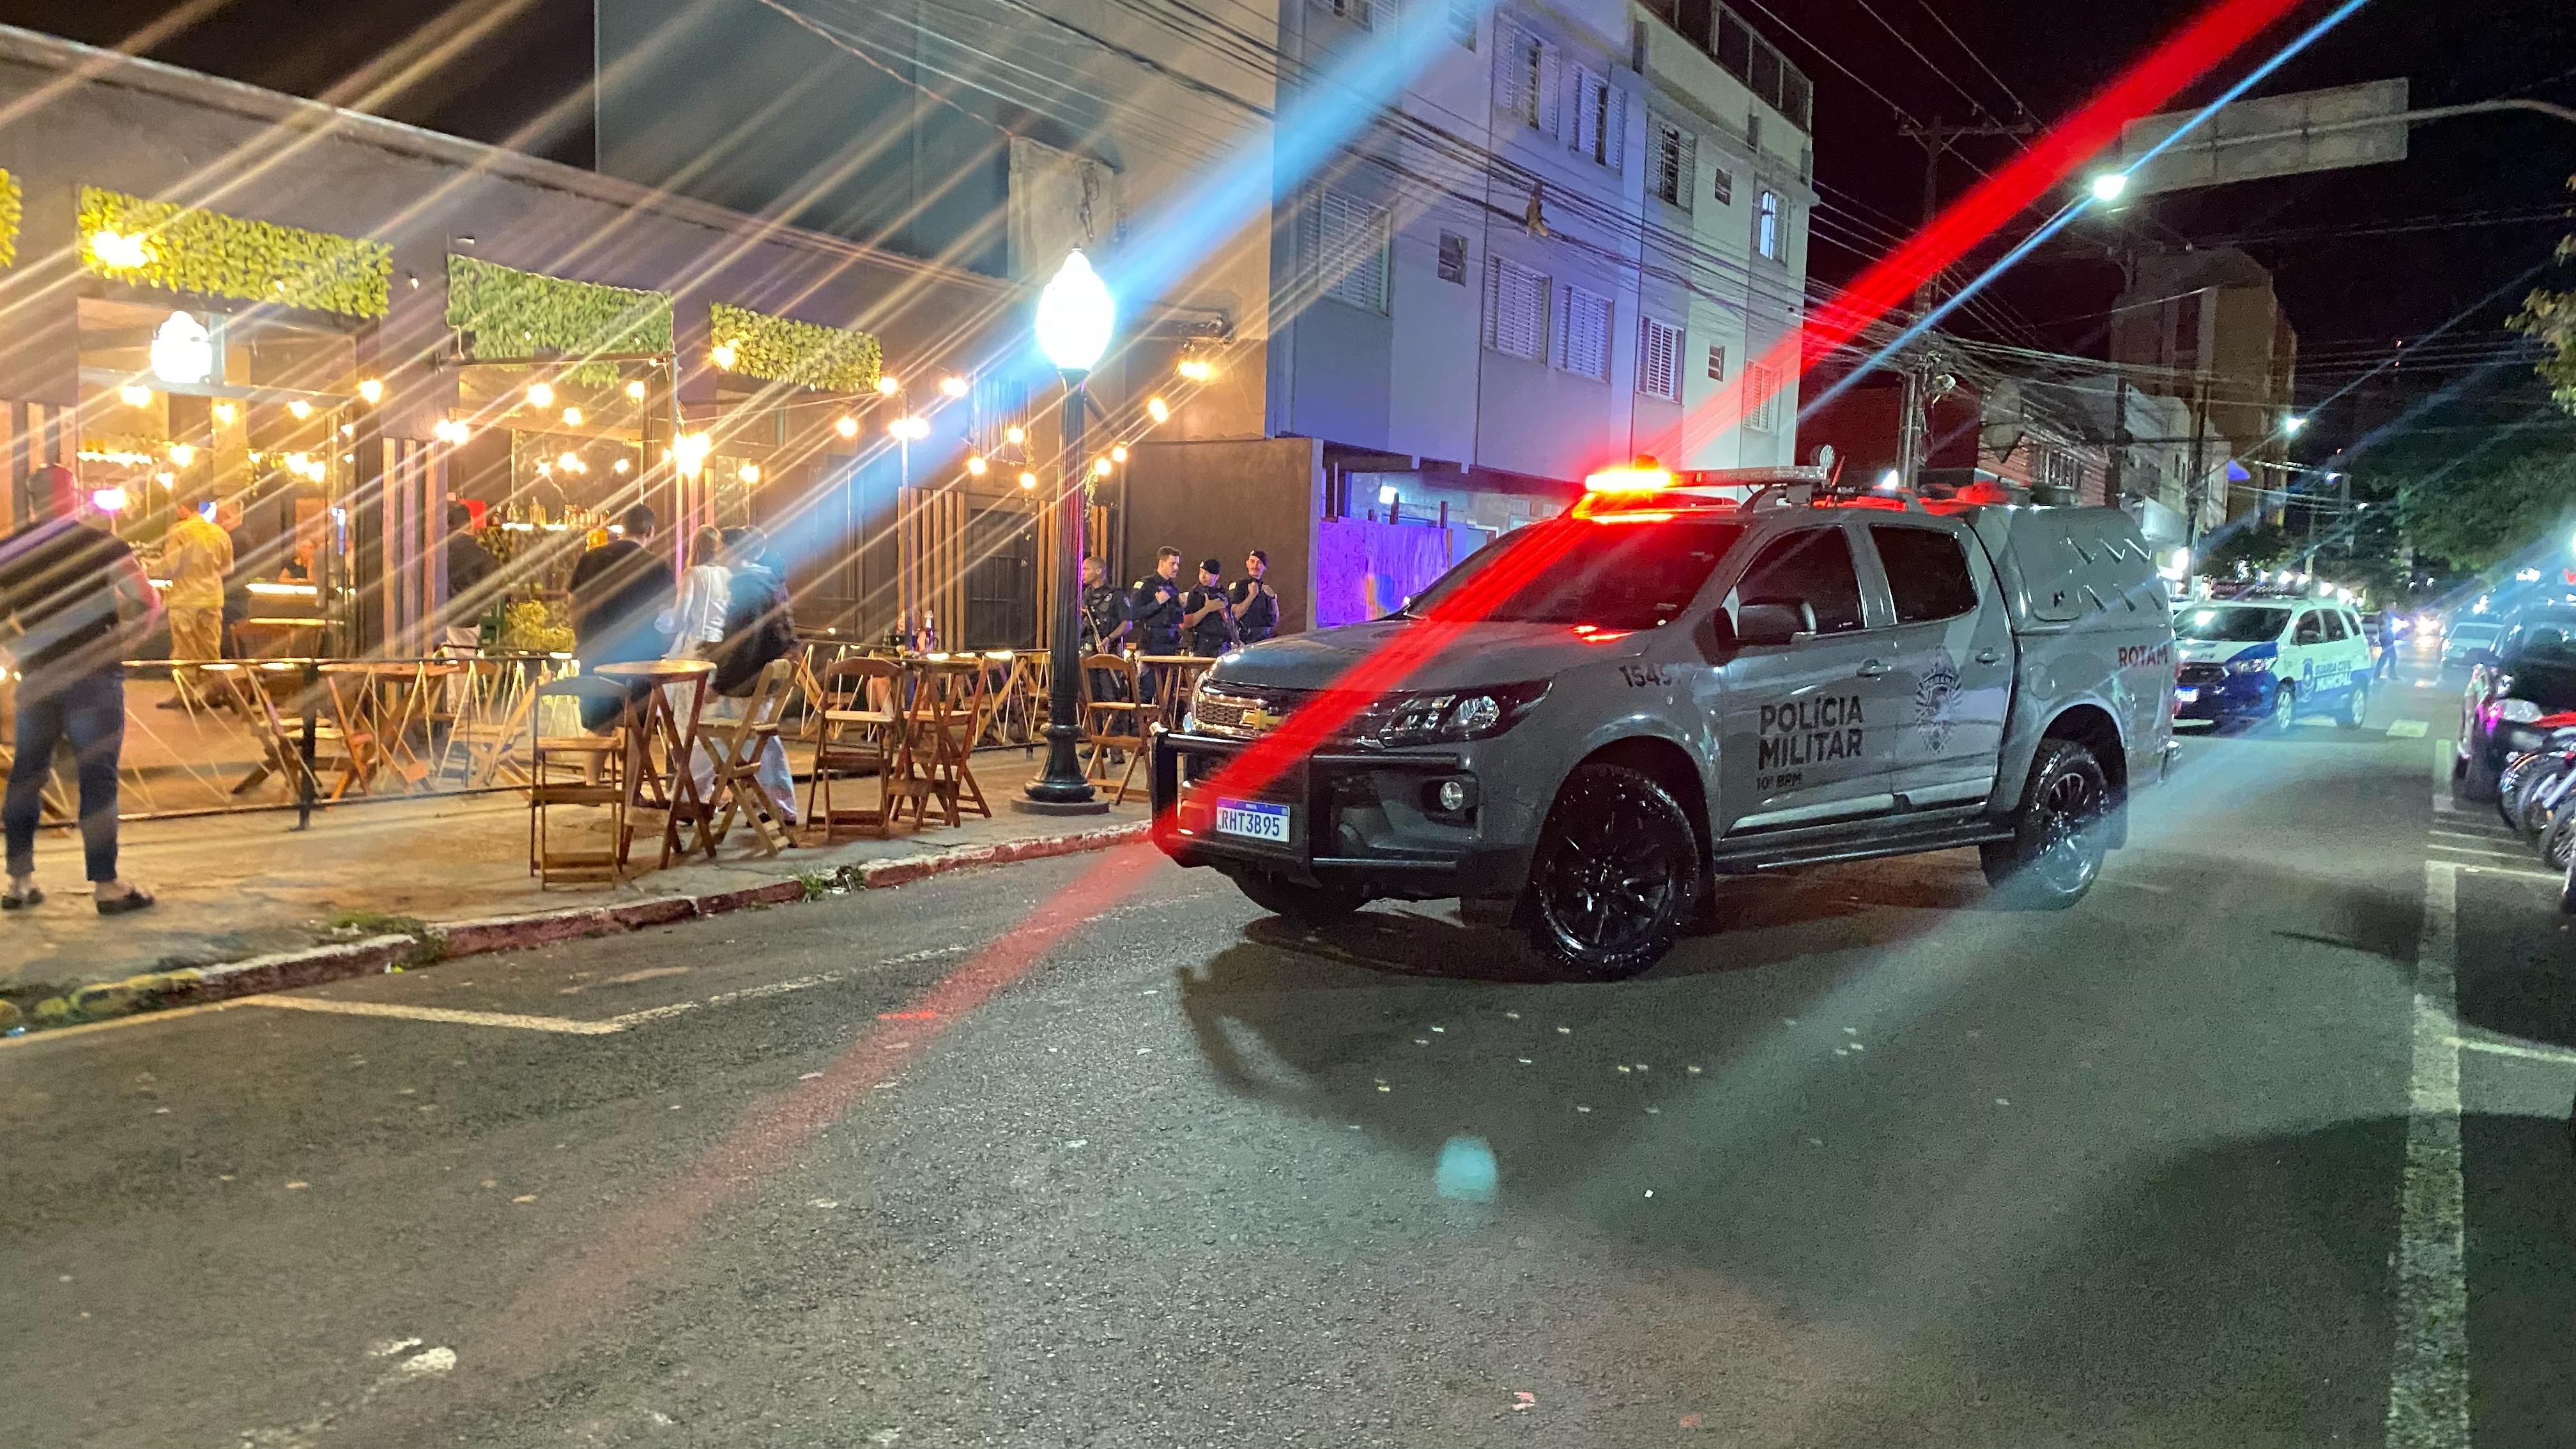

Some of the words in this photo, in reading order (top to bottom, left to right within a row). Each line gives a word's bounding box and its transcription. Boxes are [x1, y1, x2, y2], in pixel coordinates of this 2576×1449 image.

[2118, 645, 2168, 667] ROTAM
[1760, 695, 1864, 735] POLÍCIA
[1759, 728, 1864, 770] MILITAR
[1777, 772, 1802, 788] BPM
[1222, 809, 1280, 836] RHT3B95
